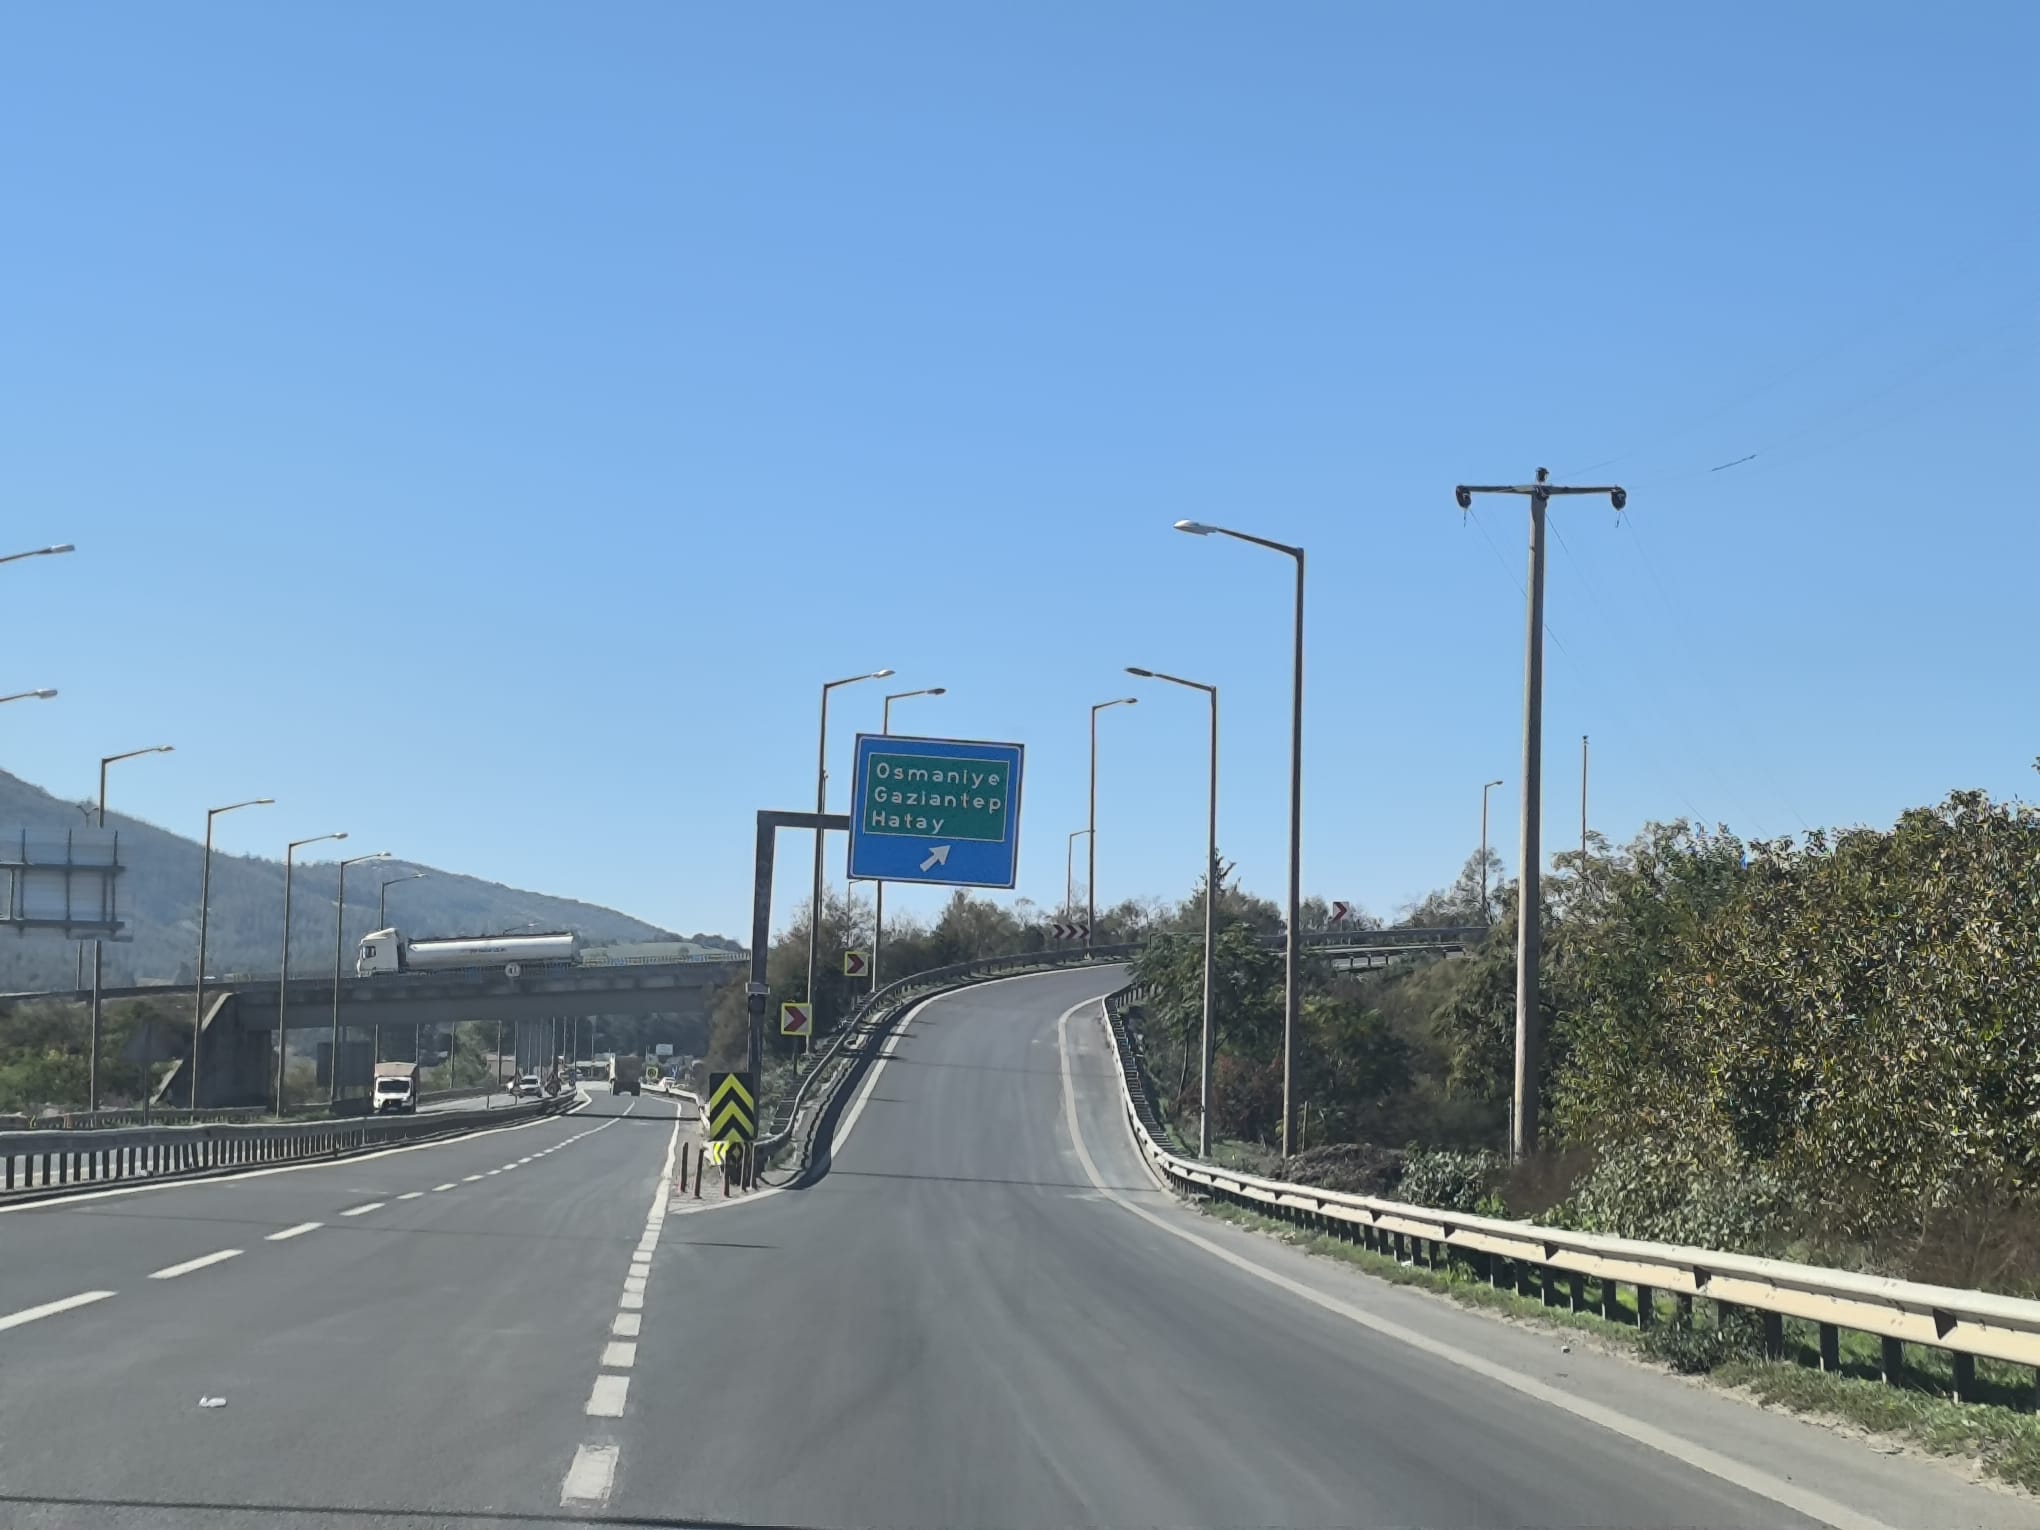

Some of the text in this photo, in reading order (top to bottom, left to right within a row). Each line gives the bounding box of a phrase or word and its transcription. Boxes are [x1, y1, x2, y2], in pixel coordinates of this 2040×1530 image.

[876, 762, 1000, 789] Osmaniye
[874, 786, 1001, 814] Gaziantep
[871, 810, 944, 834] Hatay
